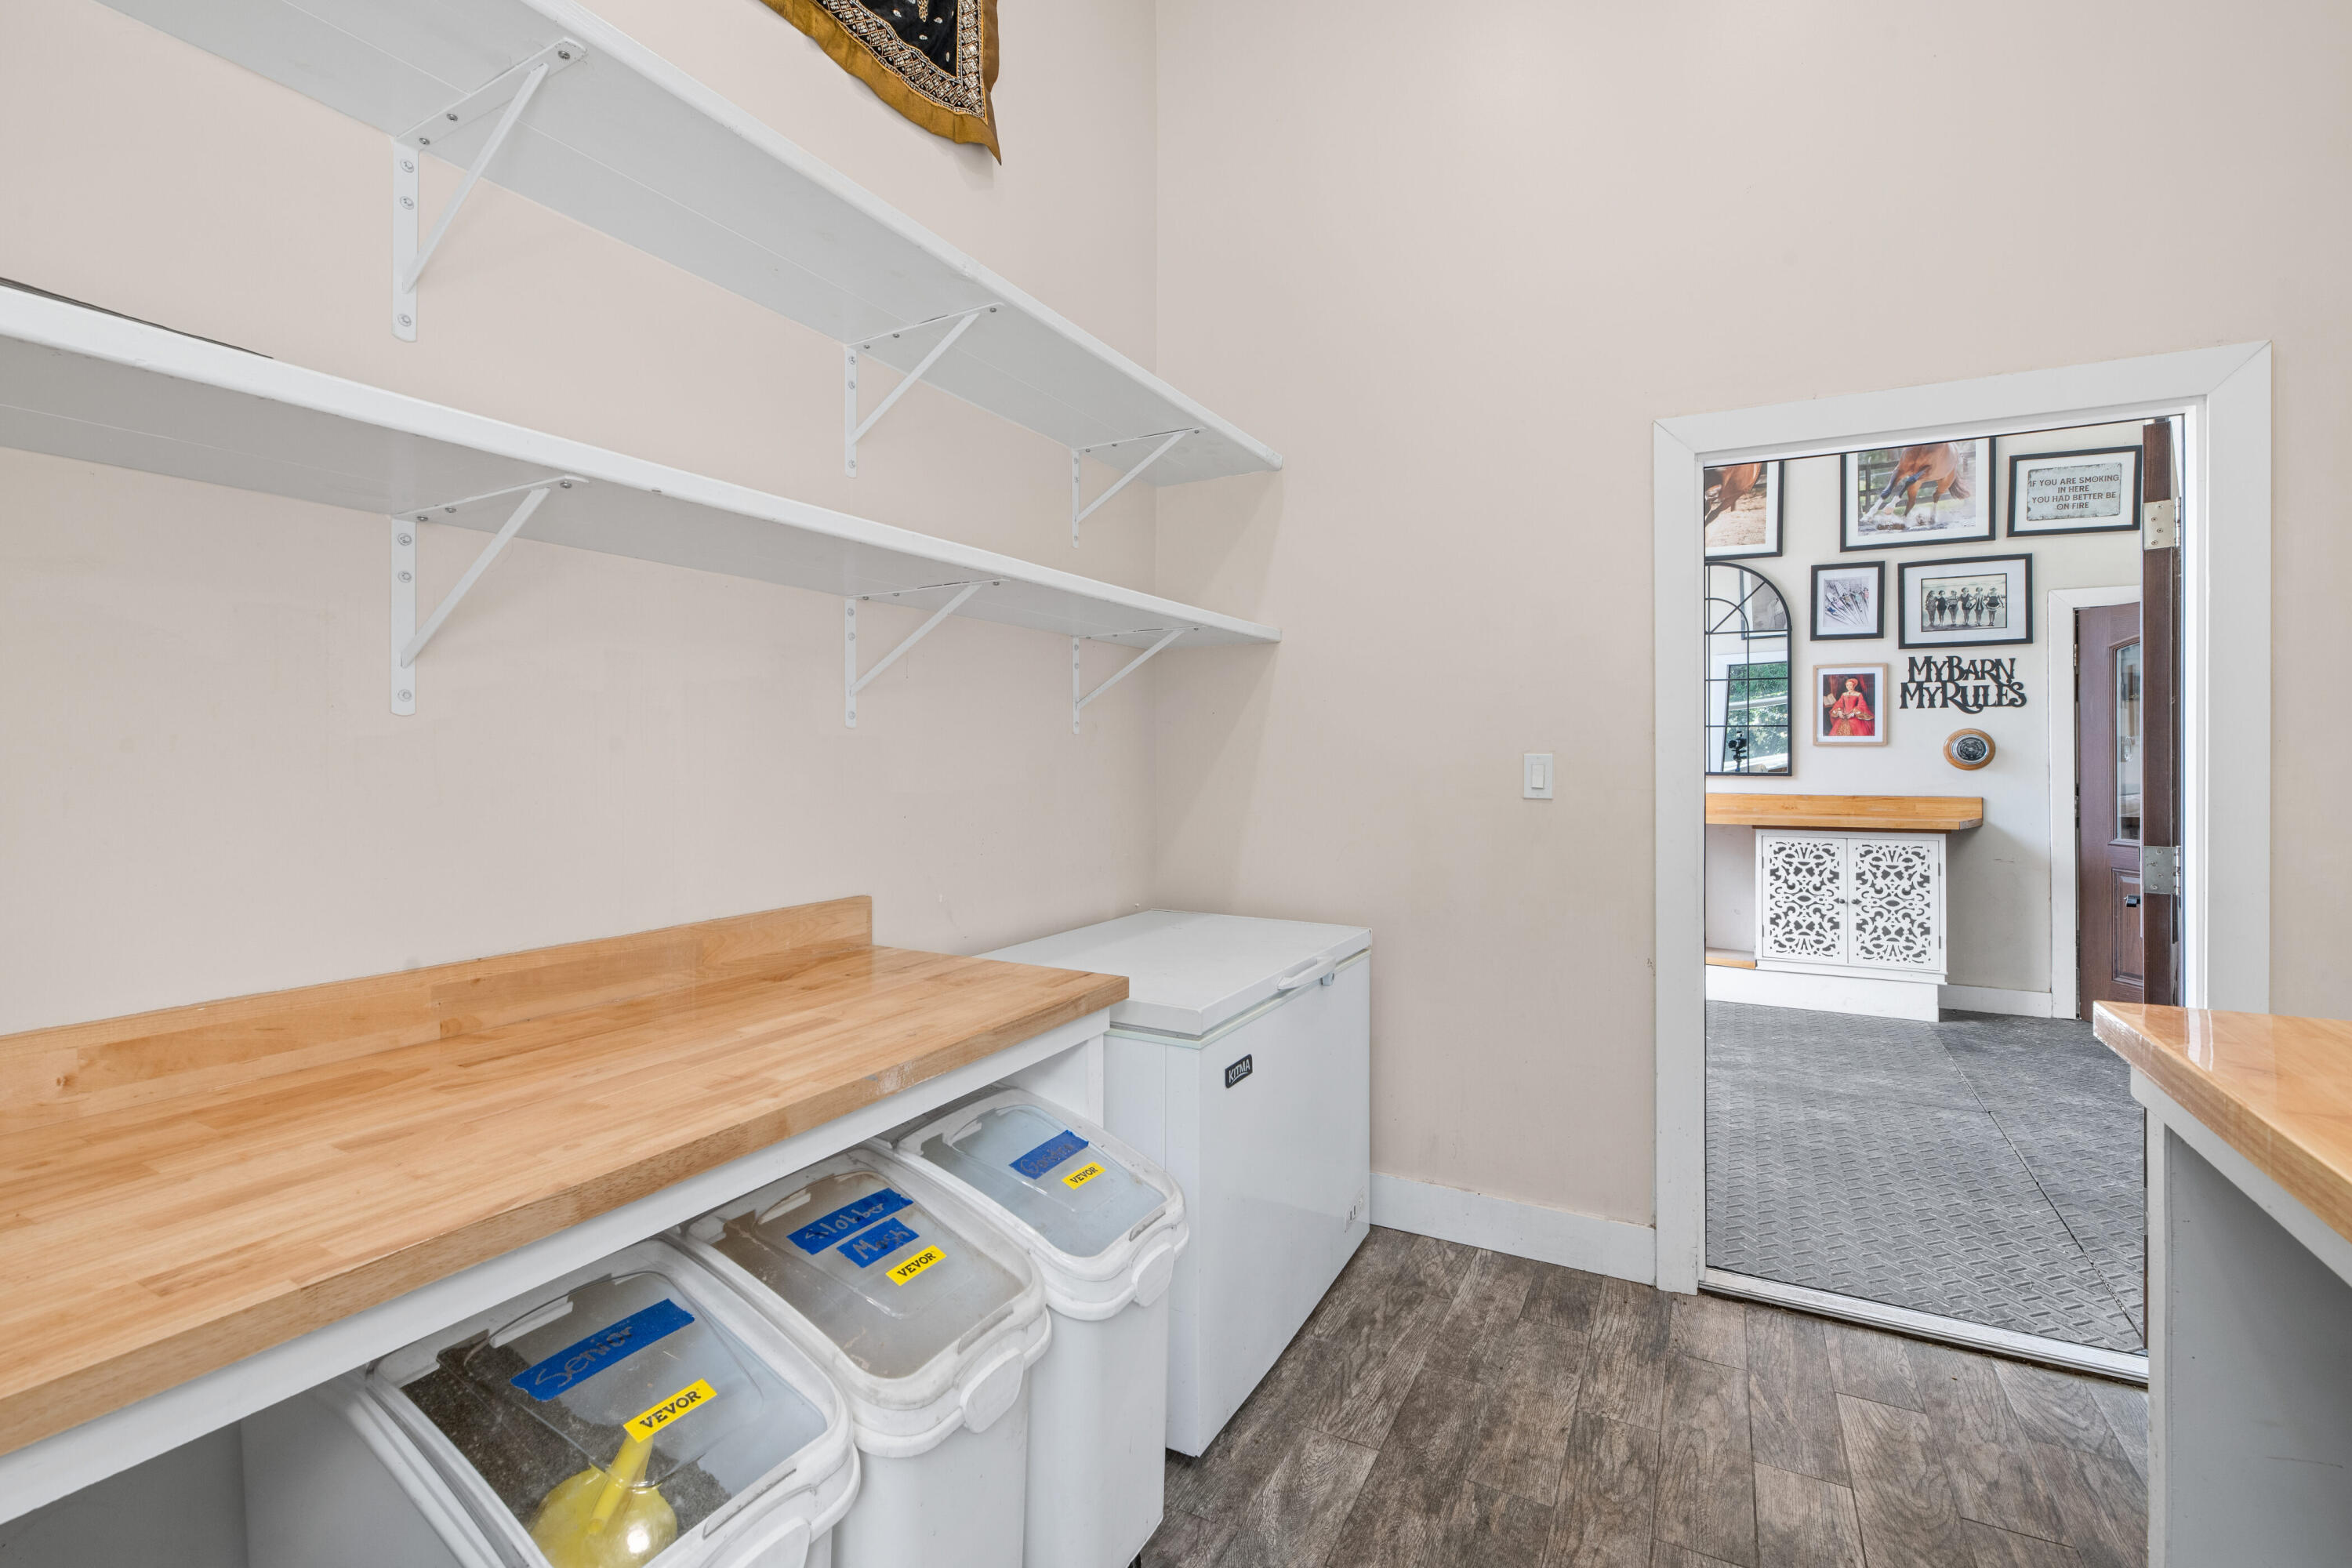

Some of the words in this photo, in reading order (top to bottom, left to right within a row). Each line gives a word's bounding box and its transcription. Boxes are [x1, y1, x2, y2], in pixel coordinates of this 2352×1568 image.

[2079, 474, 2119, 484] SMOKING
[2073, 492, 2103, 501] BETTER
[1229, 1059, 1250, 1083] KITMA
[1069, 1167, 1098, 1183] VEVOR
[897, 1252, 936, 1277] VEVOR
[535, 1326, 633, 1388] Senior
[639, 1390, 702, 1428] VEVOR
